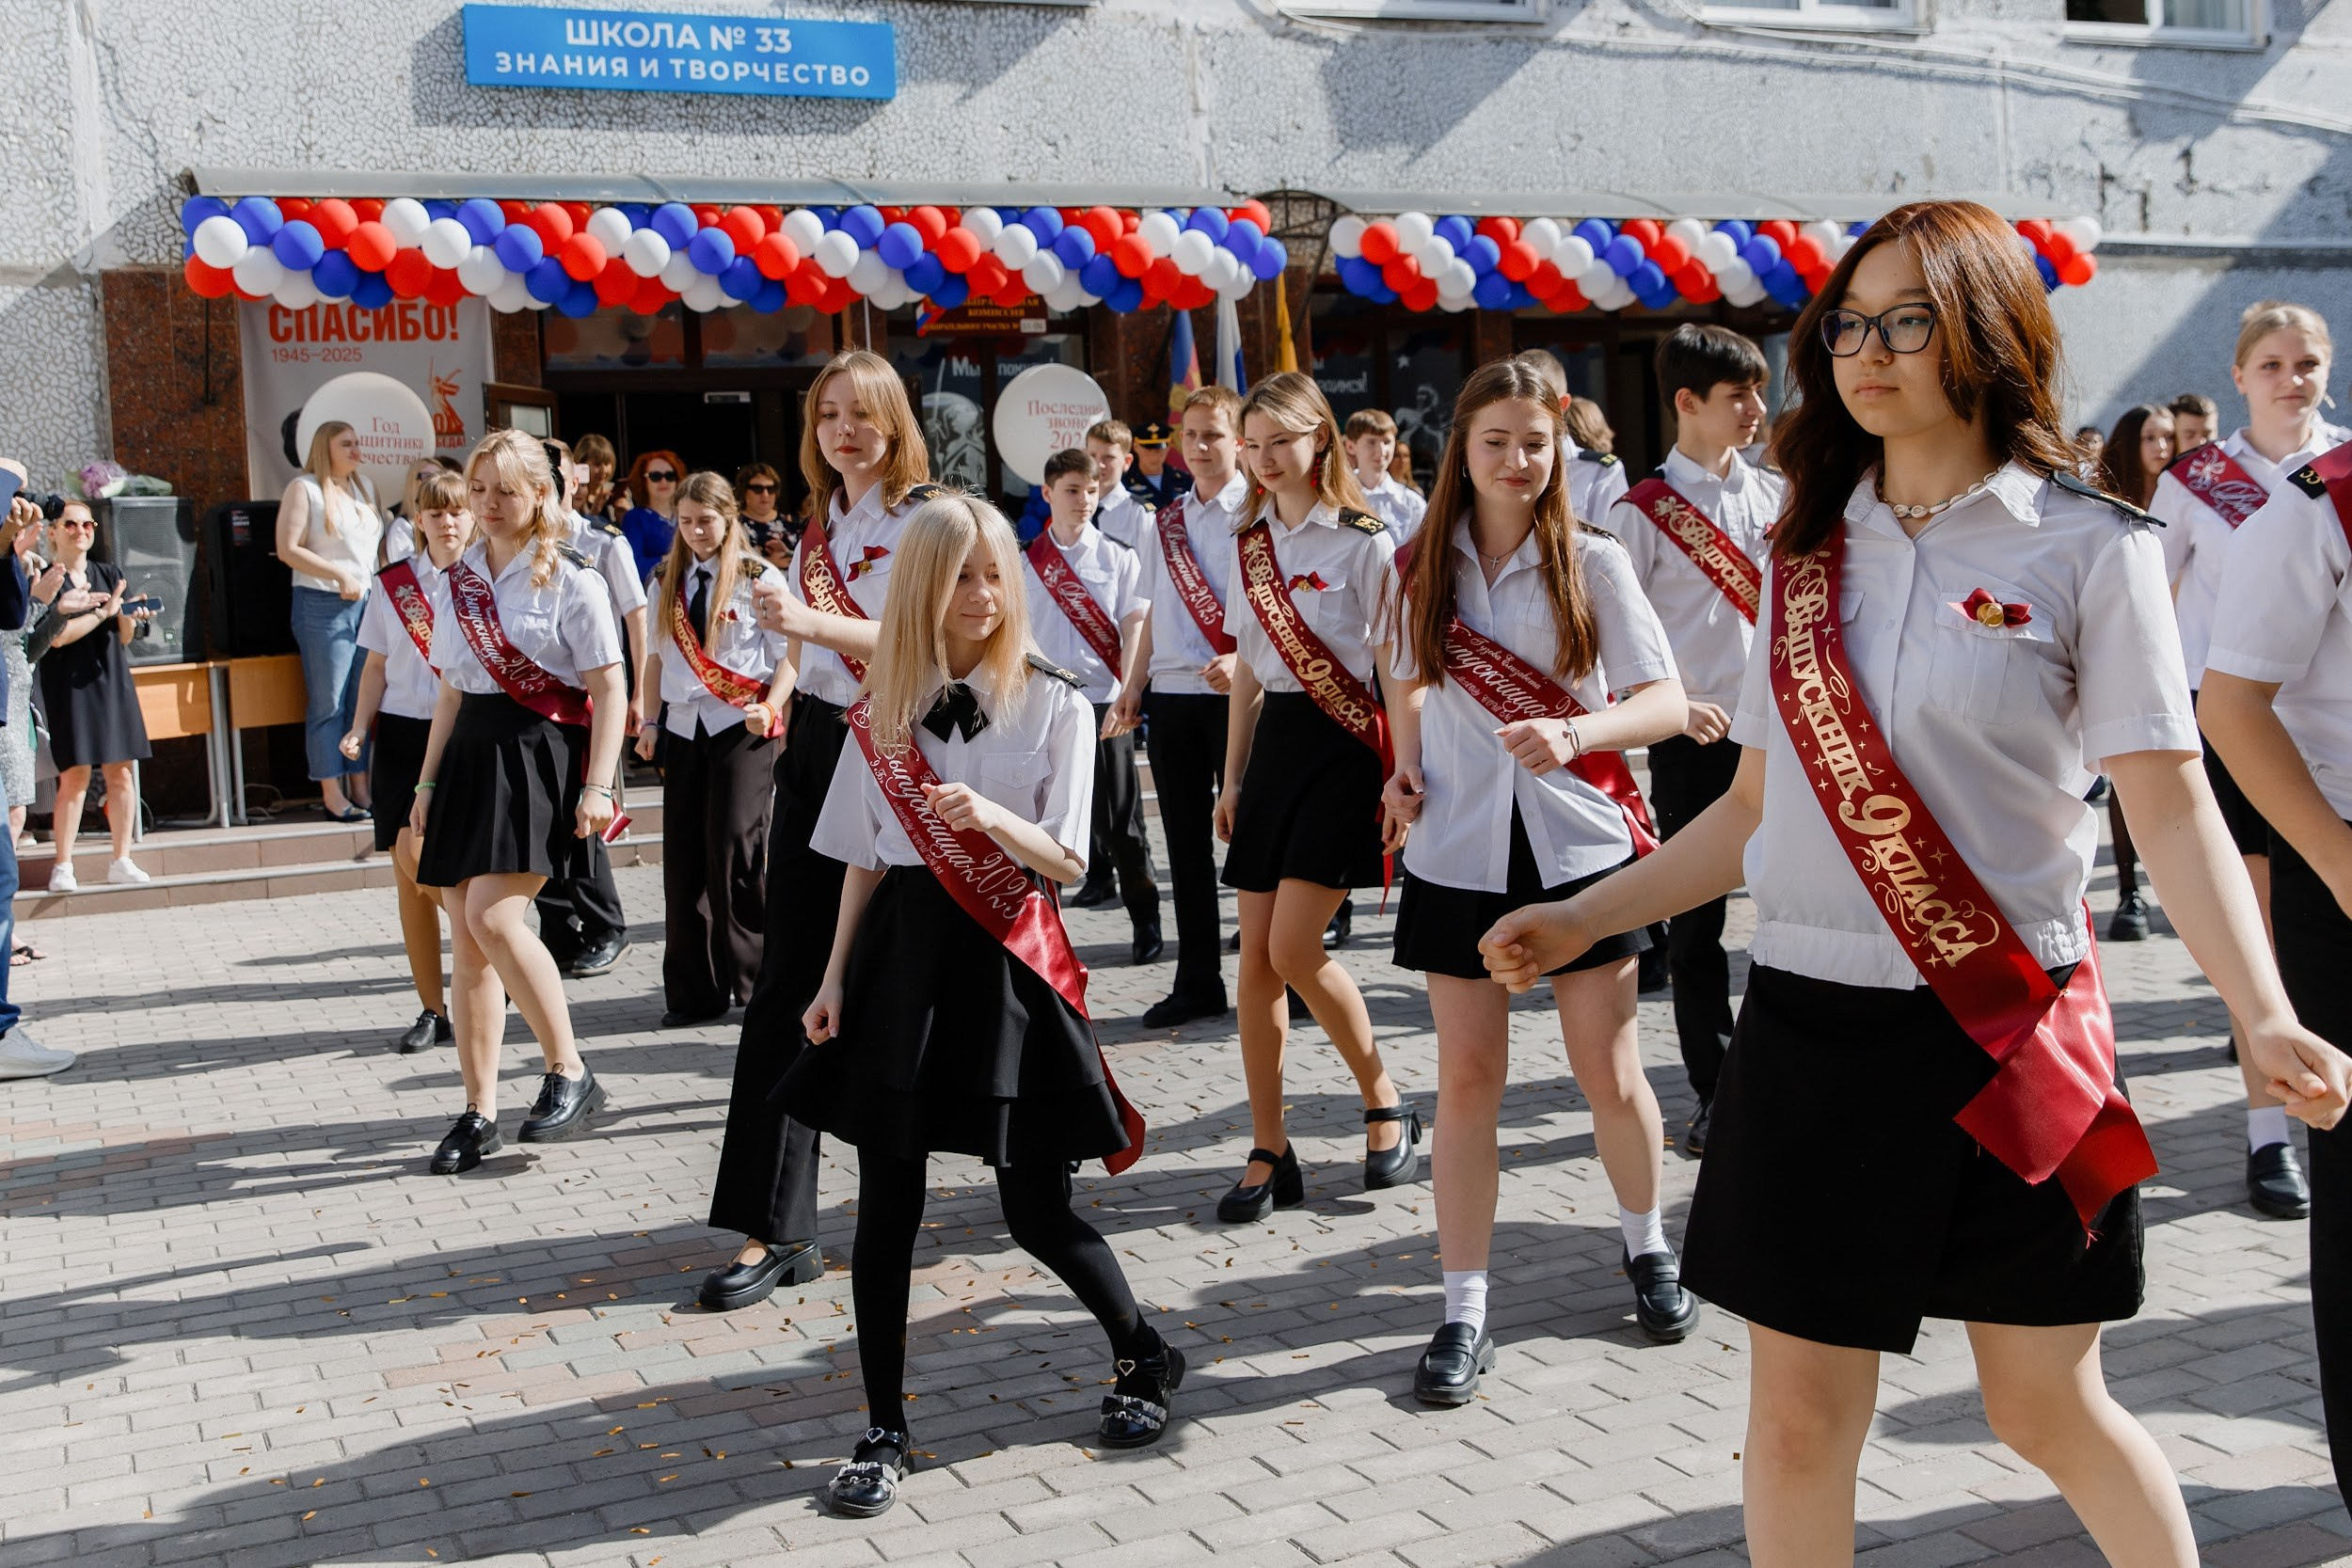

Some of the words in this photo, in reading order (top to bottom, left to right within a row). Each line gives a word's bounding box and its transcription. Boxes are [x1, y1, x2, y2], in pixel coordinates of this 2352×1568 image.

[566, 19, 700, 50] ШКОЛА
[710, 25, 746, 51] №
[755, 28, 792, 54] 33
[495, 52, 628, 77] ЗНАНИЯ
[641, 57, 659, 78] И
[669, 58, 870, 87] ТВОРЧЕСТВО
[268, 303, 459, 343] СПАСИБО!
[373, 417, 401, 435] Год
[1048, 430, 1083, 449] 202
[1189, 585, 1224, 626] 2025
[1296, 657, 1333, 682] 9
[1313, 675, 1376, 732] КЛАССА
[869, 758, 881, 768] 9
[1839, 793, 1912, 837] 9
[959, 850, 1045, 920] 2025
[1868, 831, 1976, 969] КЛАССА
